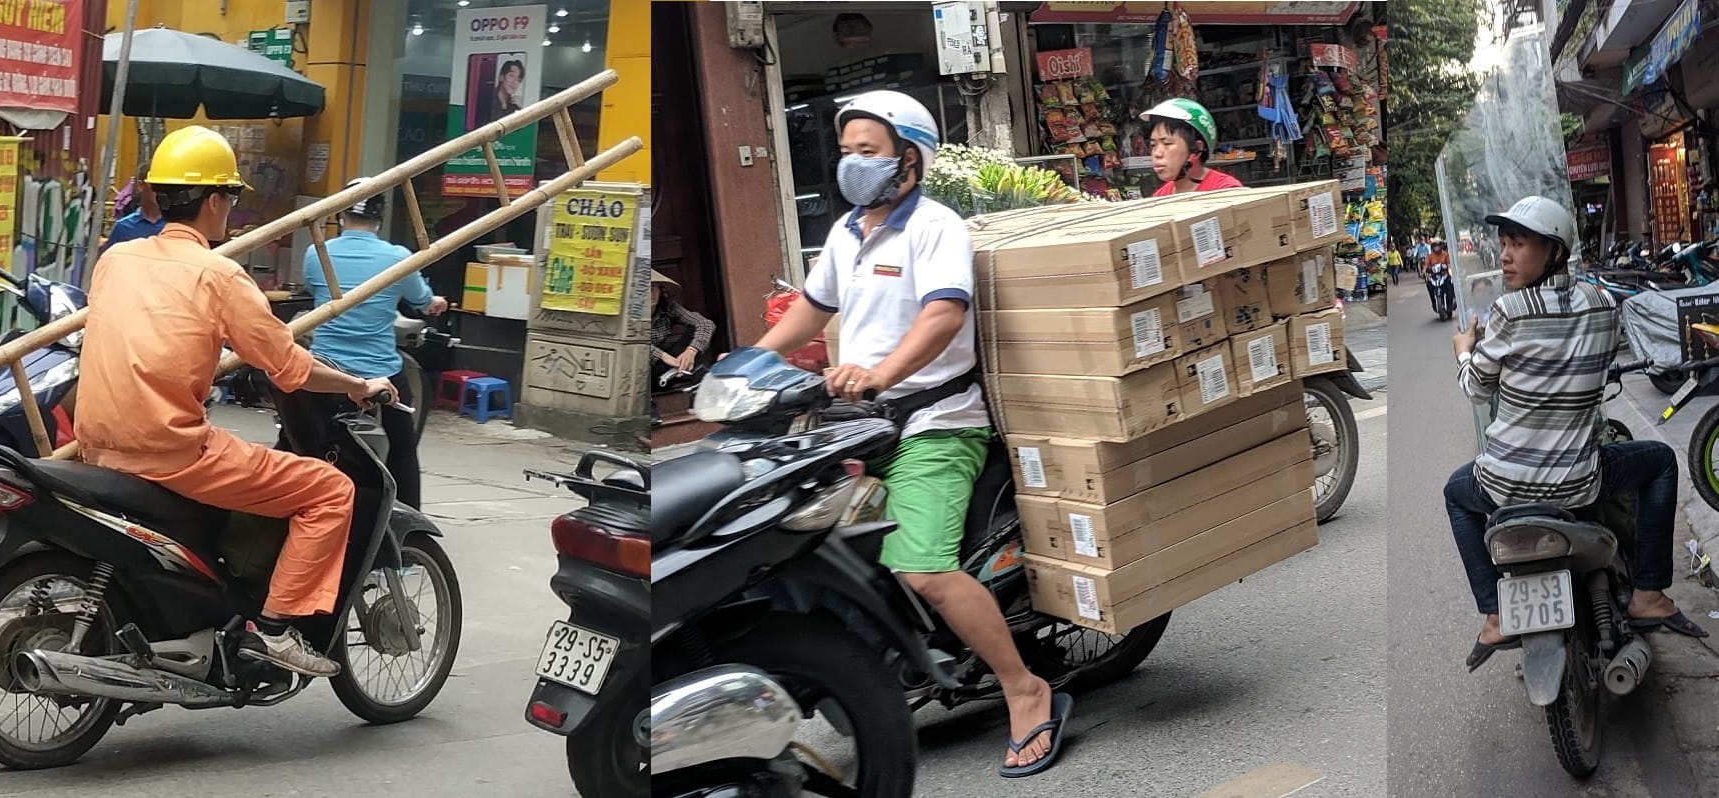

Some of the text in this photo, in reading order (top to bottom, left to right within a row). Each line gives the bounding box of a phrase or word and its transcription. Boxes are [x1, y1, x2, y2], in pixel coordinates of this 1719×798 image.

[471, 16, 529, 32] OPPO F9
[1047, 53, 1082, 76] Oishi
[566, 195, 624, 218] CHÁO
[1509, 575, 1563, 605] 29-S3
[1510, 600, 1565, 630] 5705
[554, 626, 609, 662] 29-S5
[543, 651, 595, 686] 3339
